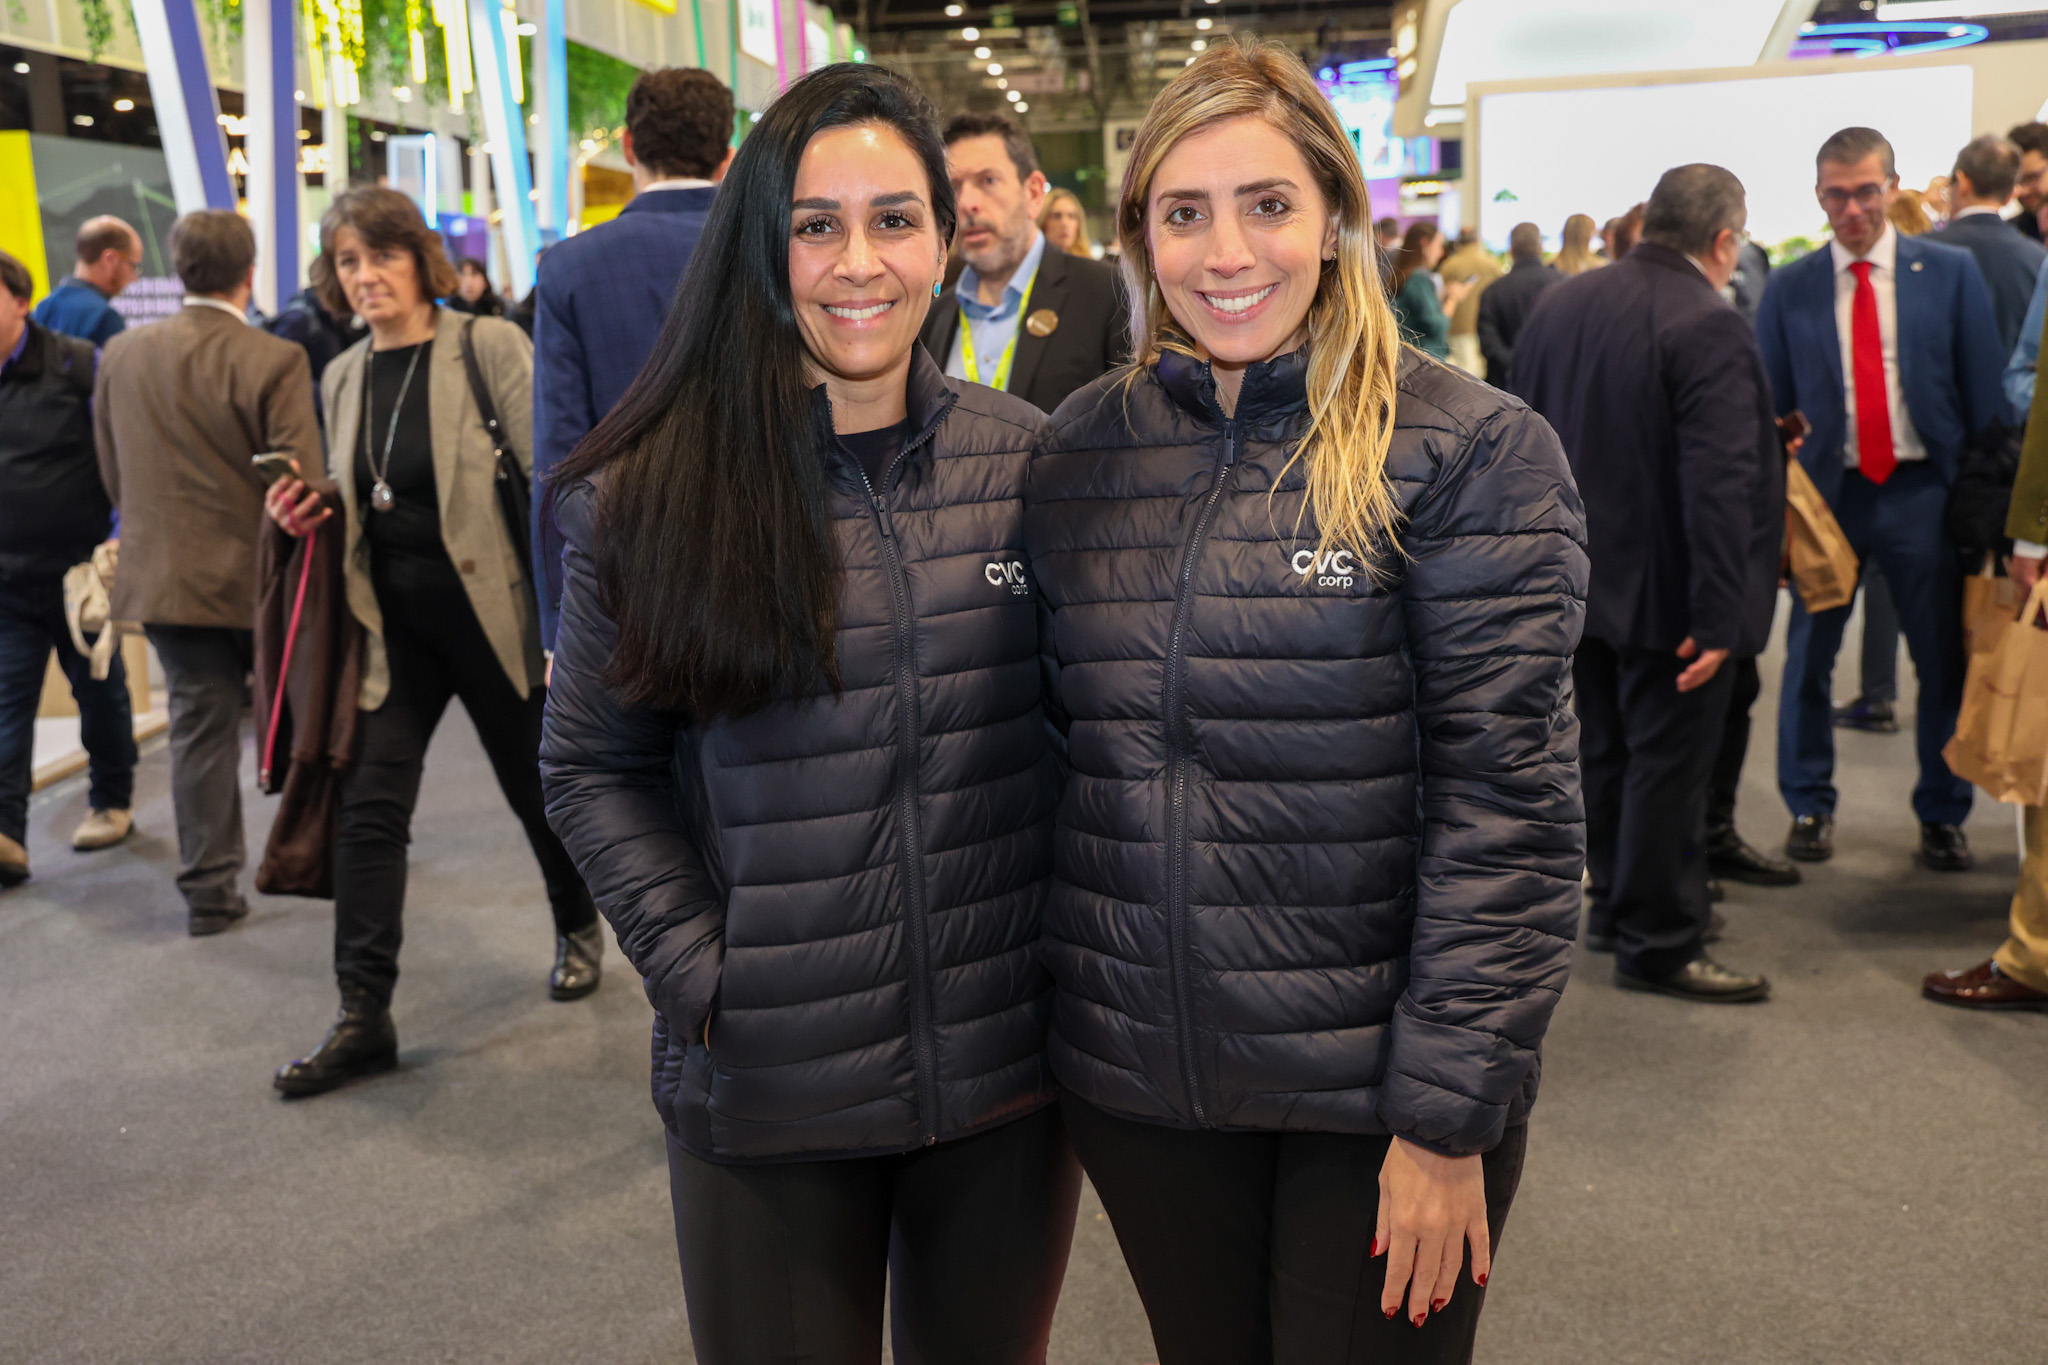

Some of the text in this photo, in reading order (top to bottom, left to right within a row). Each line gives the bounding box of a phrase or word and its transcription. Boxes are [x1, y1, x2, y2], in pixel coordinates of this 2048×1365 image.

[985, 561, 1025, 586] CVC
[1291, 549, 1354, 575] CVC
[1318, 576, 1353, 589] corp
